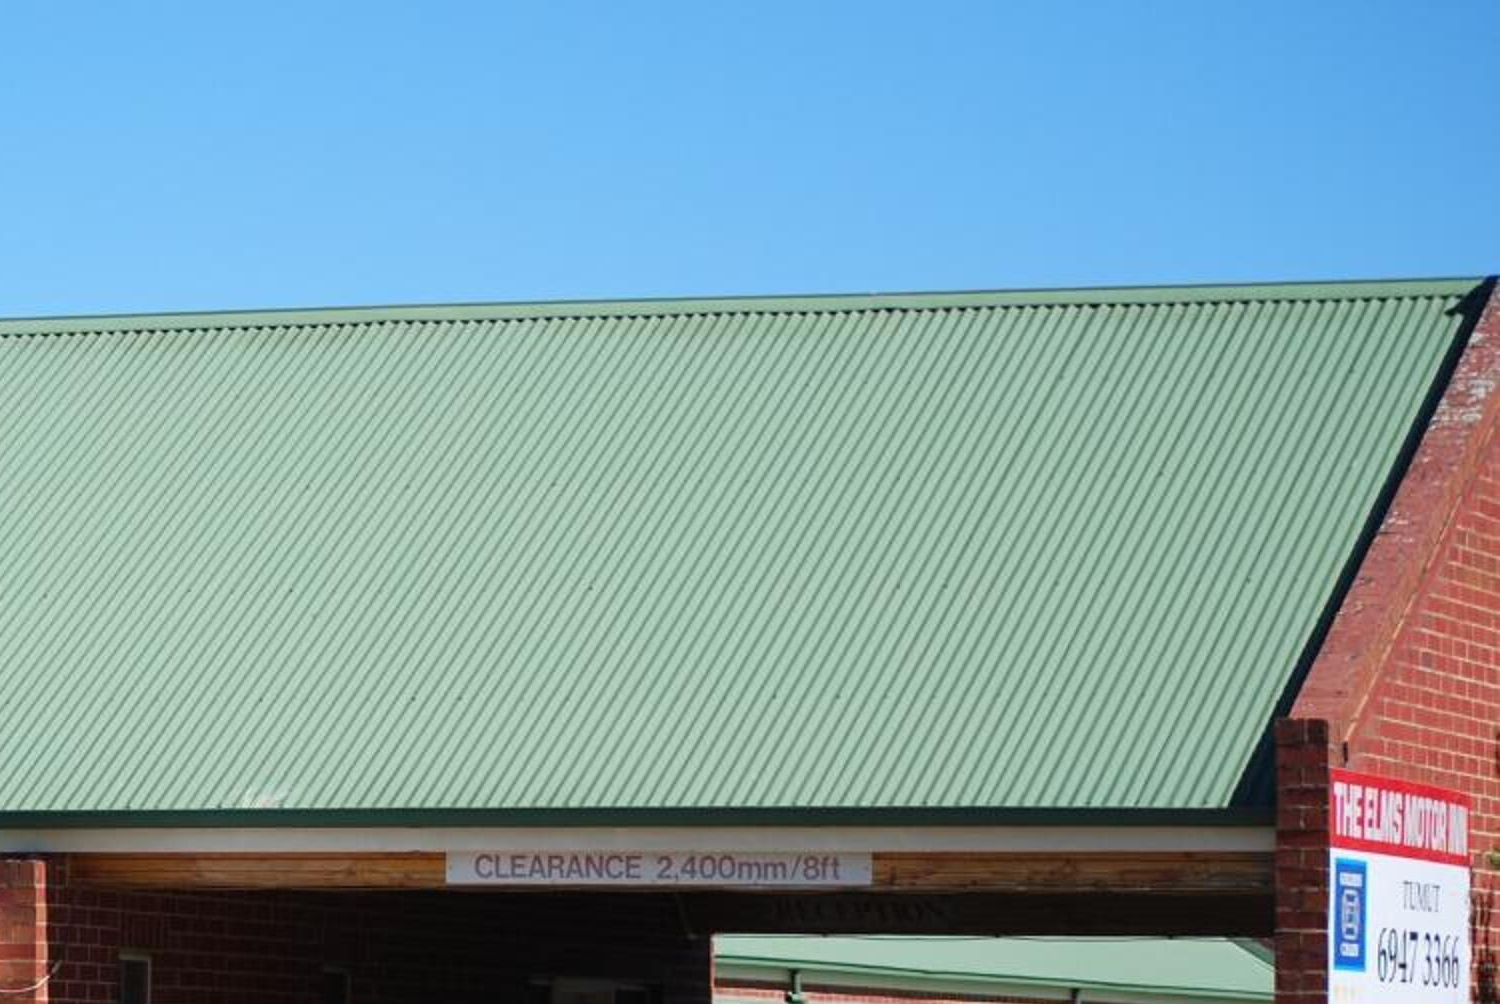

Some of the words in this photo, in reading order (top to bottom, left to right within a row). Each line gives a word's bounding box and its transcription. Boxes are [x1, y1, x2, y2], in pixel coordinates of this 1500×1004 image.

[1333, 781, 1363, 839] THE
[1364, 787, 1404, 845] ELMS
[1404, 793, 1447, 852] MOTOR
[474, 854, 642, 880] CLEARANCE
[656, 854, 841, 883] 2,400mm/8ft
[1402, 880, 1440, 912] TUMUT
[1377, 927, 1418, 983] 6947
[1422, 931, 1460, 988] 3366
